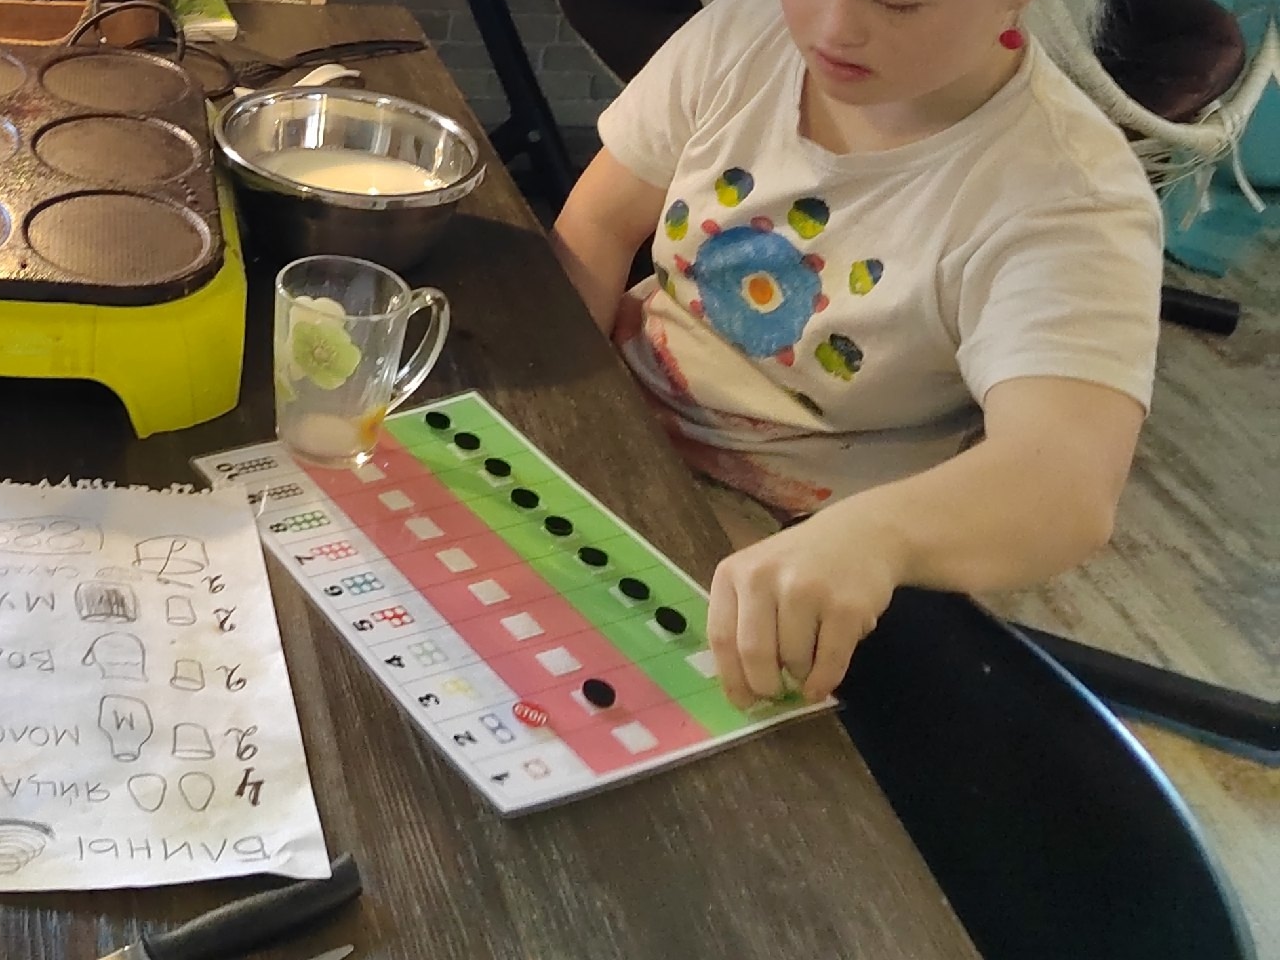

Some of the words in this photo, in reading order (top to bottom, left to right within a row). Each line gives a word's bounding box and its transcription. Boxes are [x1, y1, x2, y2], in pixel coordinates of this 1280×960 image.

[294, 555, 314, 565] 7
[324, 585, 343, 596] 6
[352, 619, 374, 631] 5
[384, 654, 406, 669] 4
[214, 663, 248, 691] 2
[418, 693, 440, 708] 3
[514, 702, 548, 726] СТОП
[224, 724, 259, 761] 2
[453, 730, 478, 746] 2
[235, 766, 265, 807] 4
[490, 771, 510, 786] 1
[0, 772, 111, 807] ЯЙЦА
[78, 835, 271, 864] БЛИНЫ
